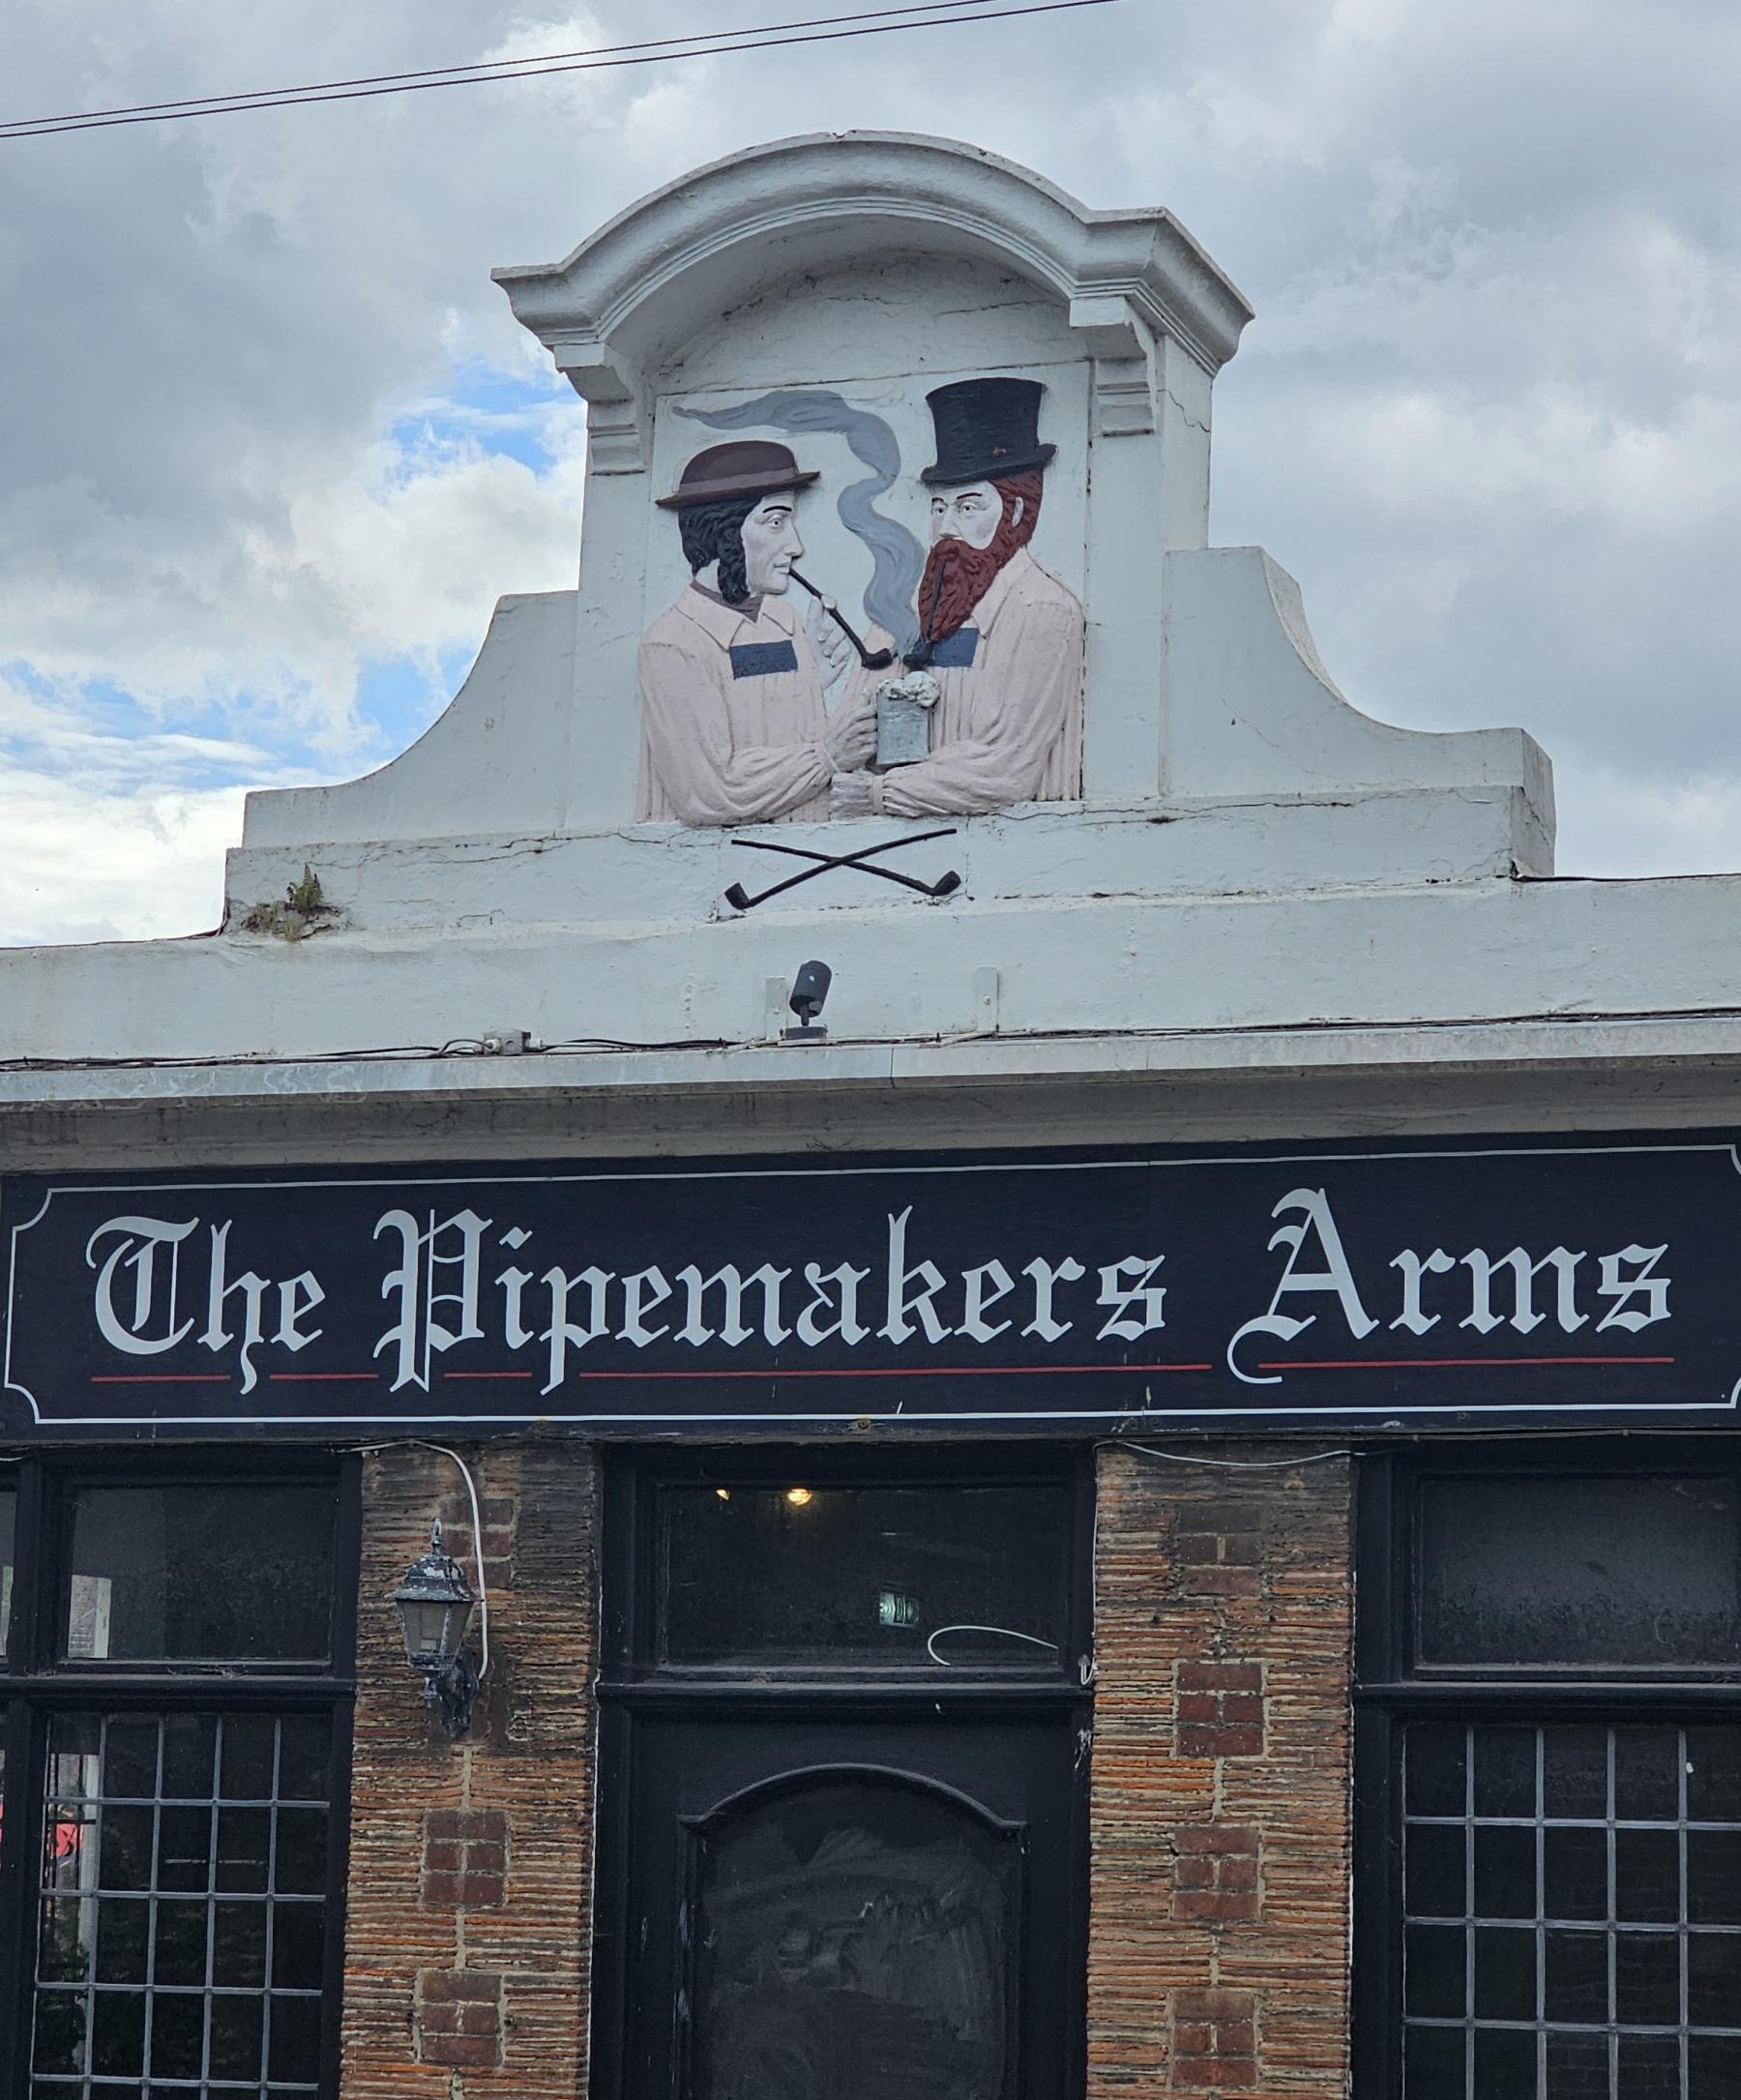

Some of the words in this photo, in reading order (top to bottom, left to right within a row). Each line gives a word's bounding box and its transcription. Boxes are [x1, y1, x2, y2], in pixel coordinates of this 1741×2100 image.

[85, 1216, 326, 1395] The
[372, 1205, 1167, 1396] Pipemakers
[1226, 1188, 1672, 1384] Arms
